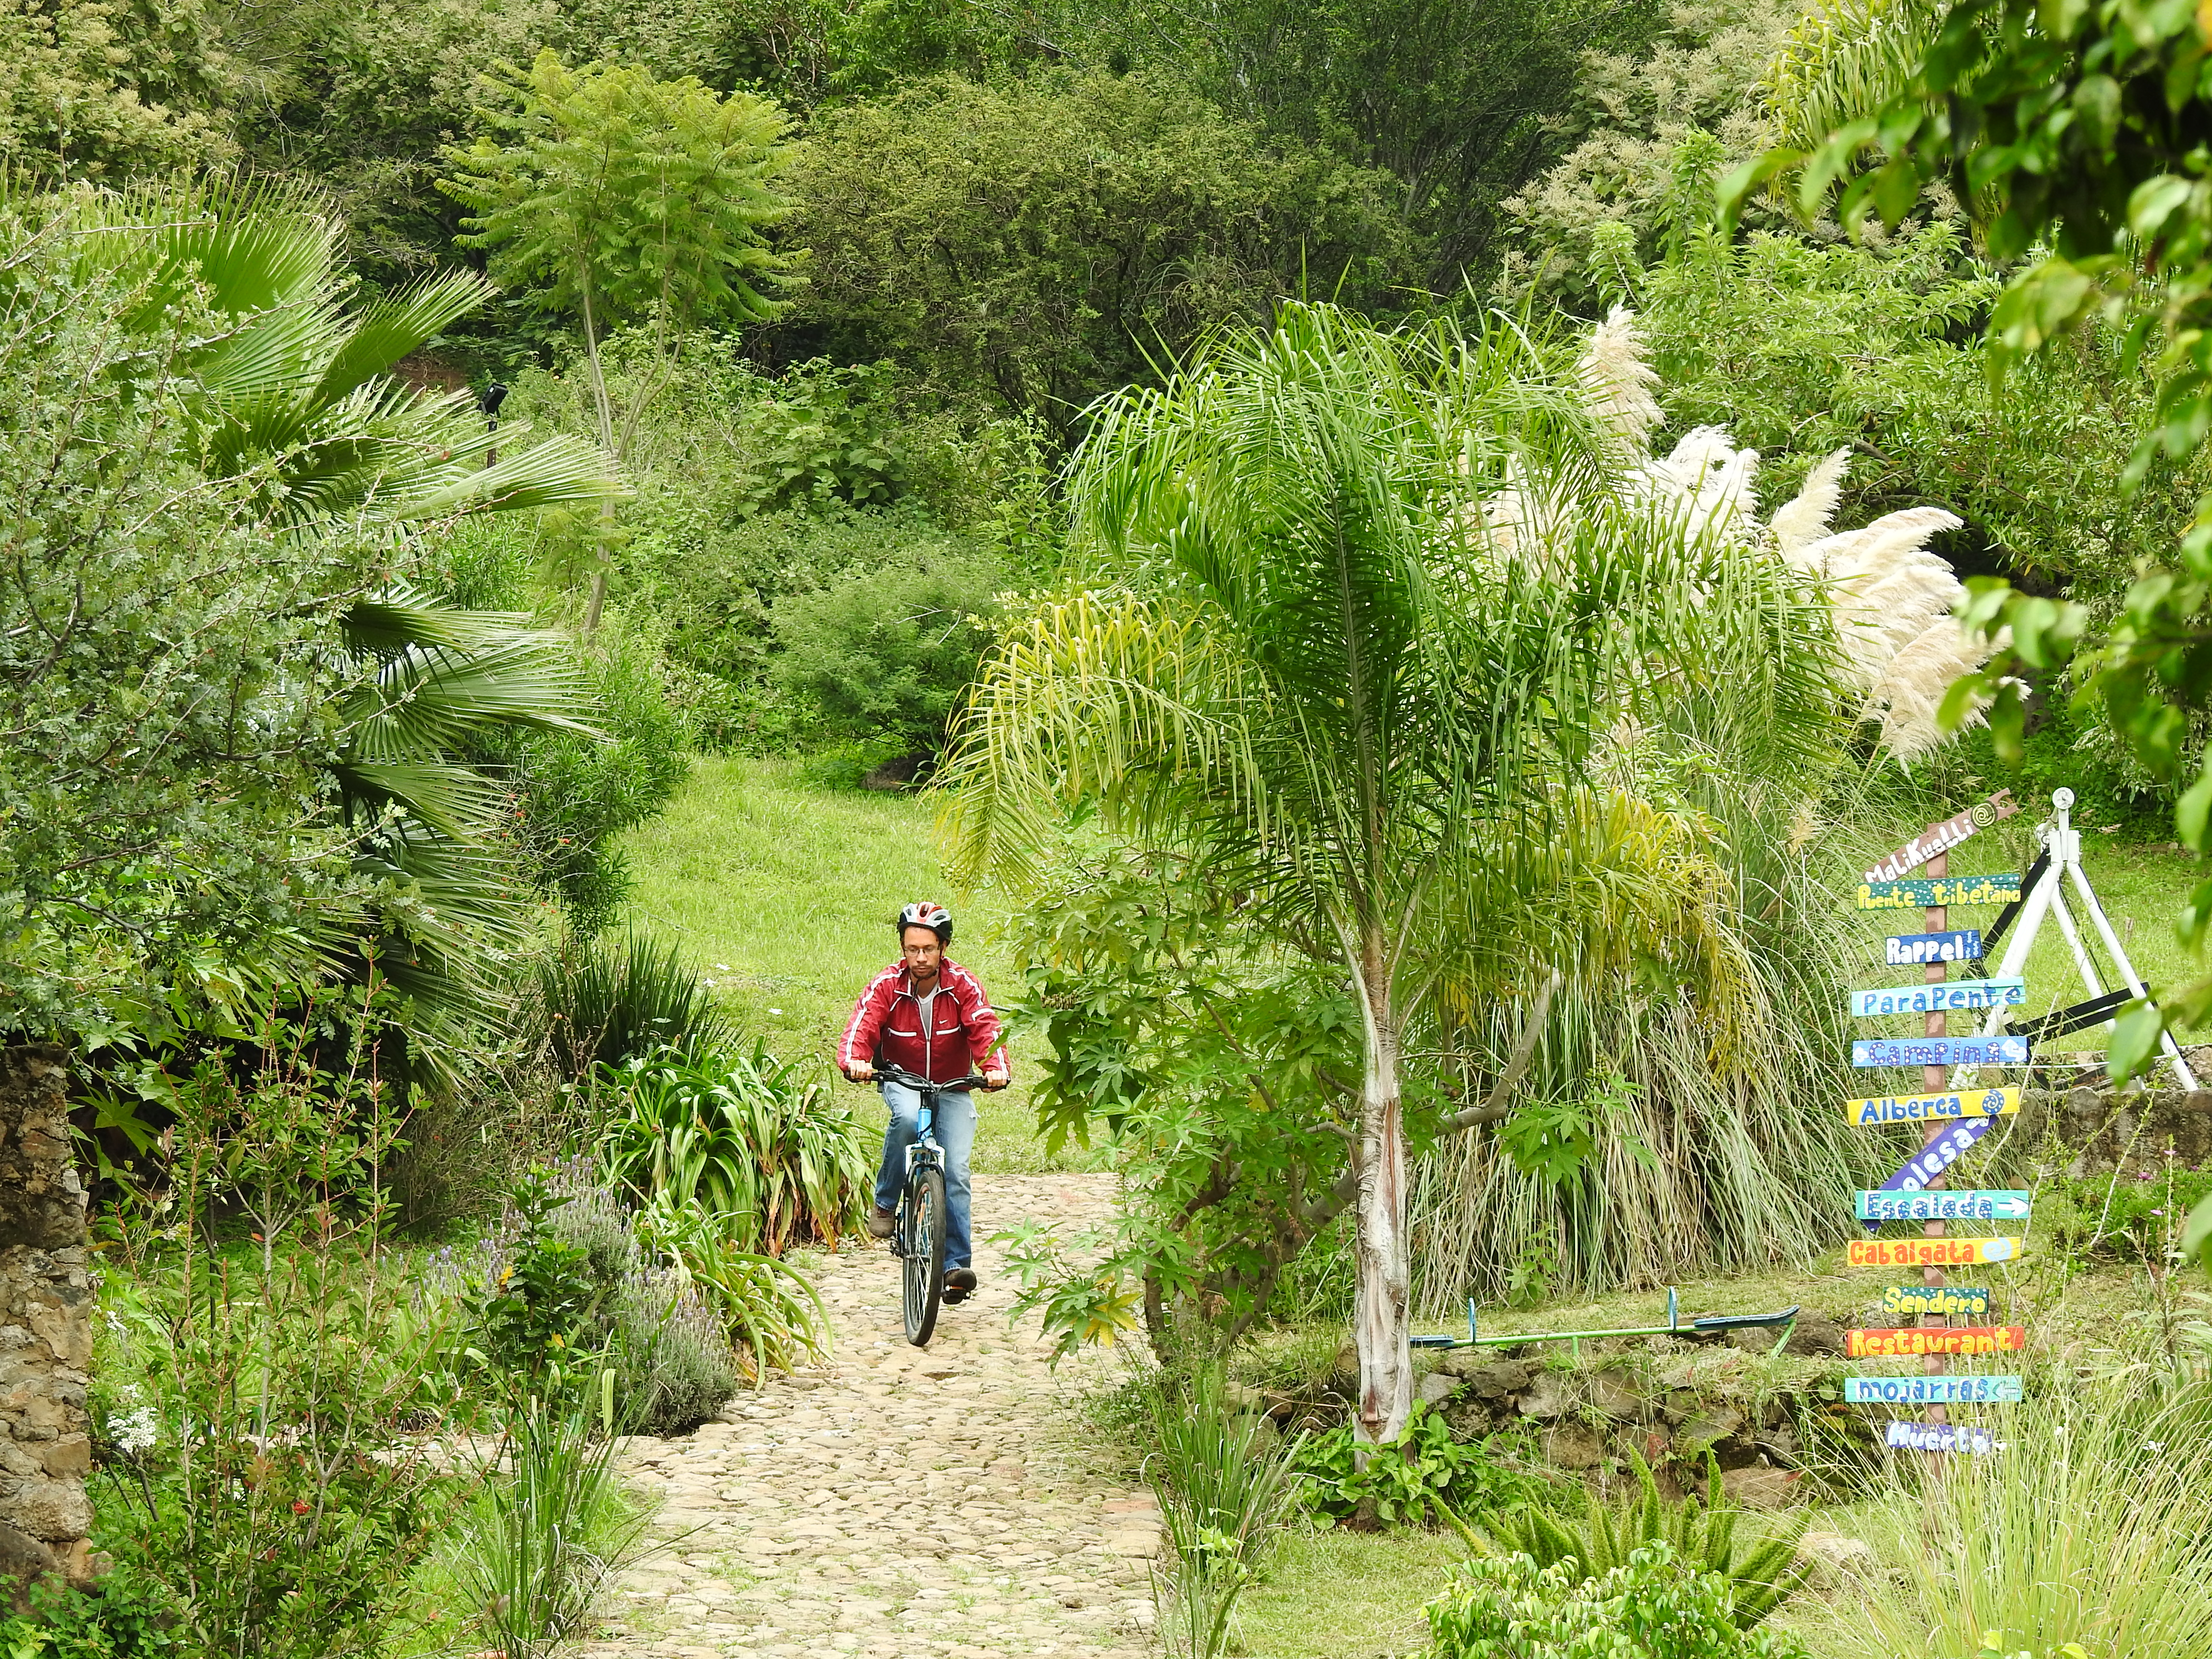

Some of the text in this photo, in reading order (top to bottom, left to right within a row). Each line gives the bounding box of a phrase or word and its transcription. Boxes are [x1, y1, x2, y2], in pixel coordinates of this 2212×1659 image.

[1857, 879, 2021, 910] Puente tibetano
[1859, 1095, 1962, 1123] Alberca
[1896, 1128, 1975, 1191] olesa
[1864, 1192, 1993, 1220] Escalada
[1850, 1241, 1974, 1265] Cabalgata
[1883, 1286, 1986, 1313] Sendero
[1851, 1327, 2013, 1357] Restaurant
[1855, 1378, 1989, 1403] mojarras
